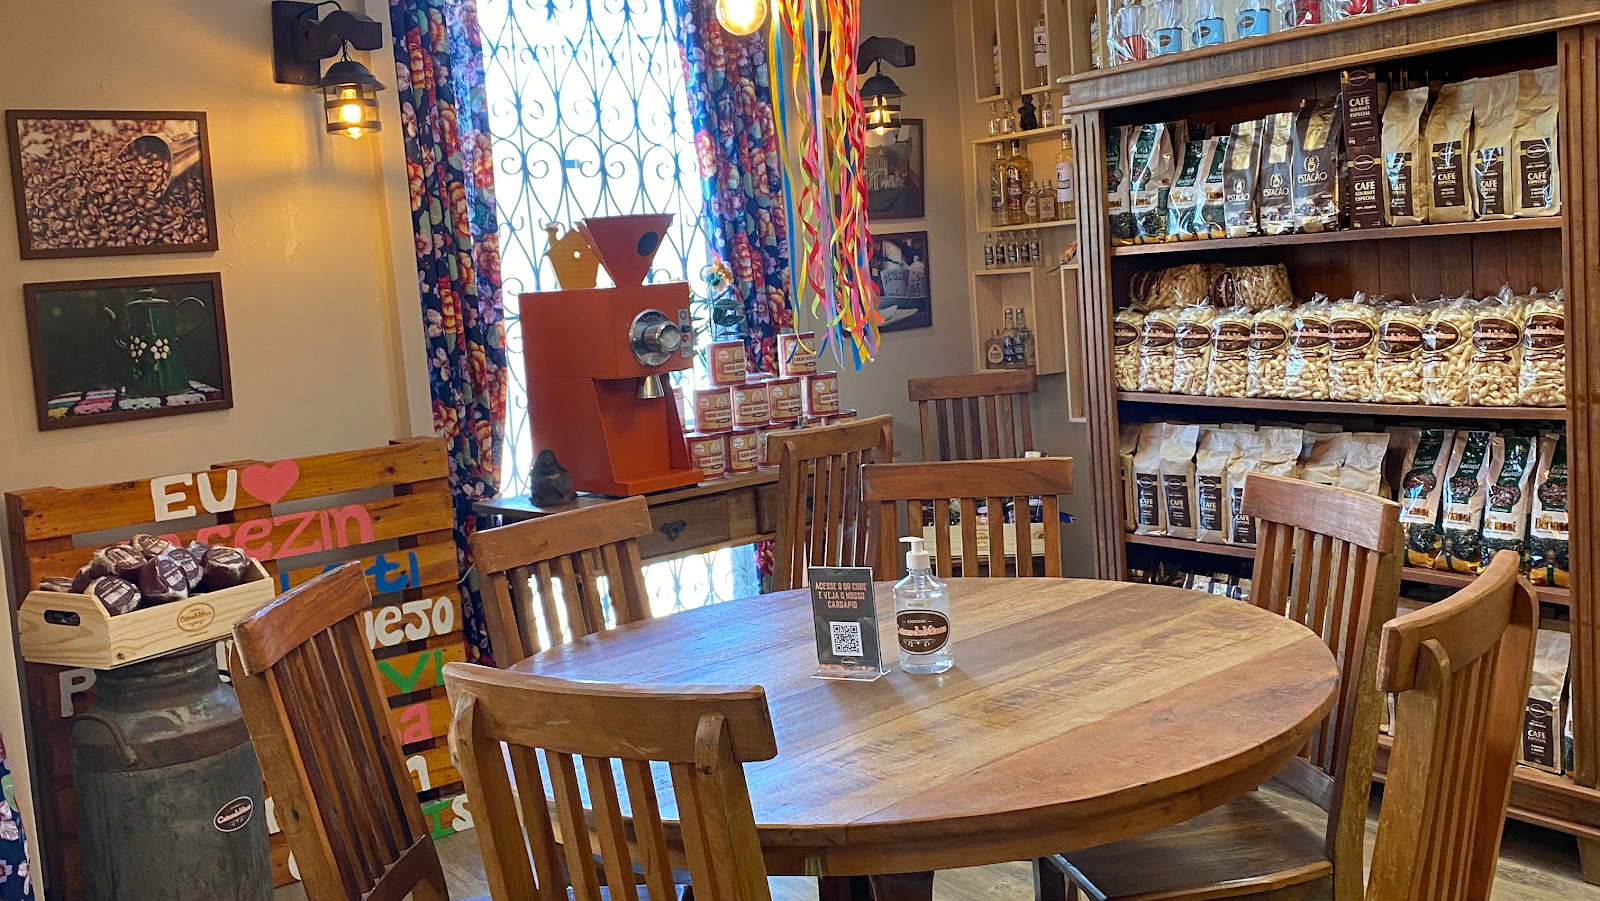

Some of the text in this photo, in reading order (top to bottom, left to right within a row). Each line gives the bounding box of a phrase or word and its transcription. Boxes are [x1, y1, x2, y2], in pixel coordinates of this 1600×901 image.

[1354, 180, 1376, 191] CAFÉ
[150, 469, 237, 522] EU
[815, 582, 867, 591] ACESSE O QR CODE
[819, 591, 865, 600] E VEJA O NOSSO
